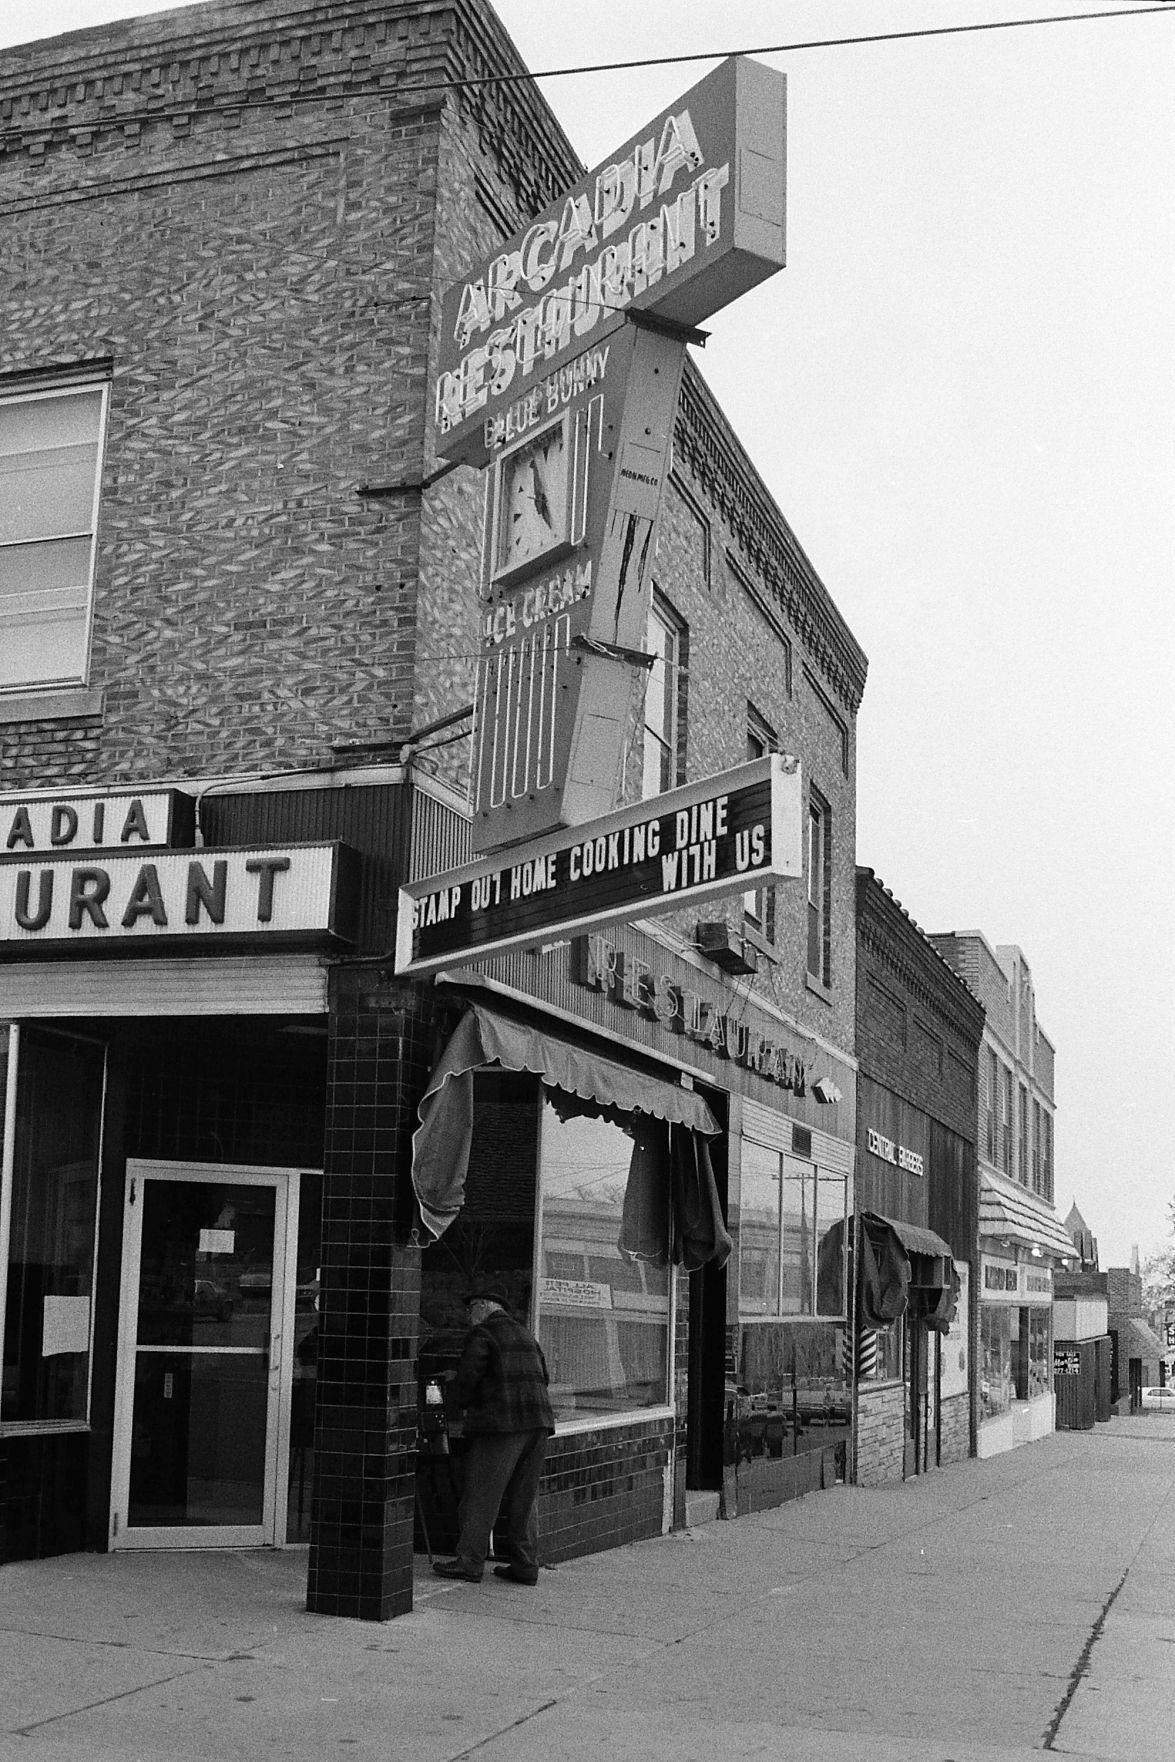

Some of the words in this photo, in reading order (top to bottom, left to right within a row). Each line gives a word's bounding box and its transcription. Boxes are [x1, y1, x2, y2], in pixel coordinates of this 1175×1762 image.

[454, 107, 705, 350] ARCADIA
[434, 162, 730, 435] RESTAURANT
[484, 386, 544, 449] BLUE
[546, 345, 611, 413] BUNNY
[6, 799, 150, 849] ADIA
[412, 885, 462, 930] STAMP
[471, 872, 501, 911] OUT
[510, 853, 557, 900] HOME
[570, 820, 660, 882] COOKING
[675, 796, 729, 849] DINE
[661, 839, 717, 892] WITH
[734, 824, 765, 871] US
[15, 857, 290, 931] URANT
